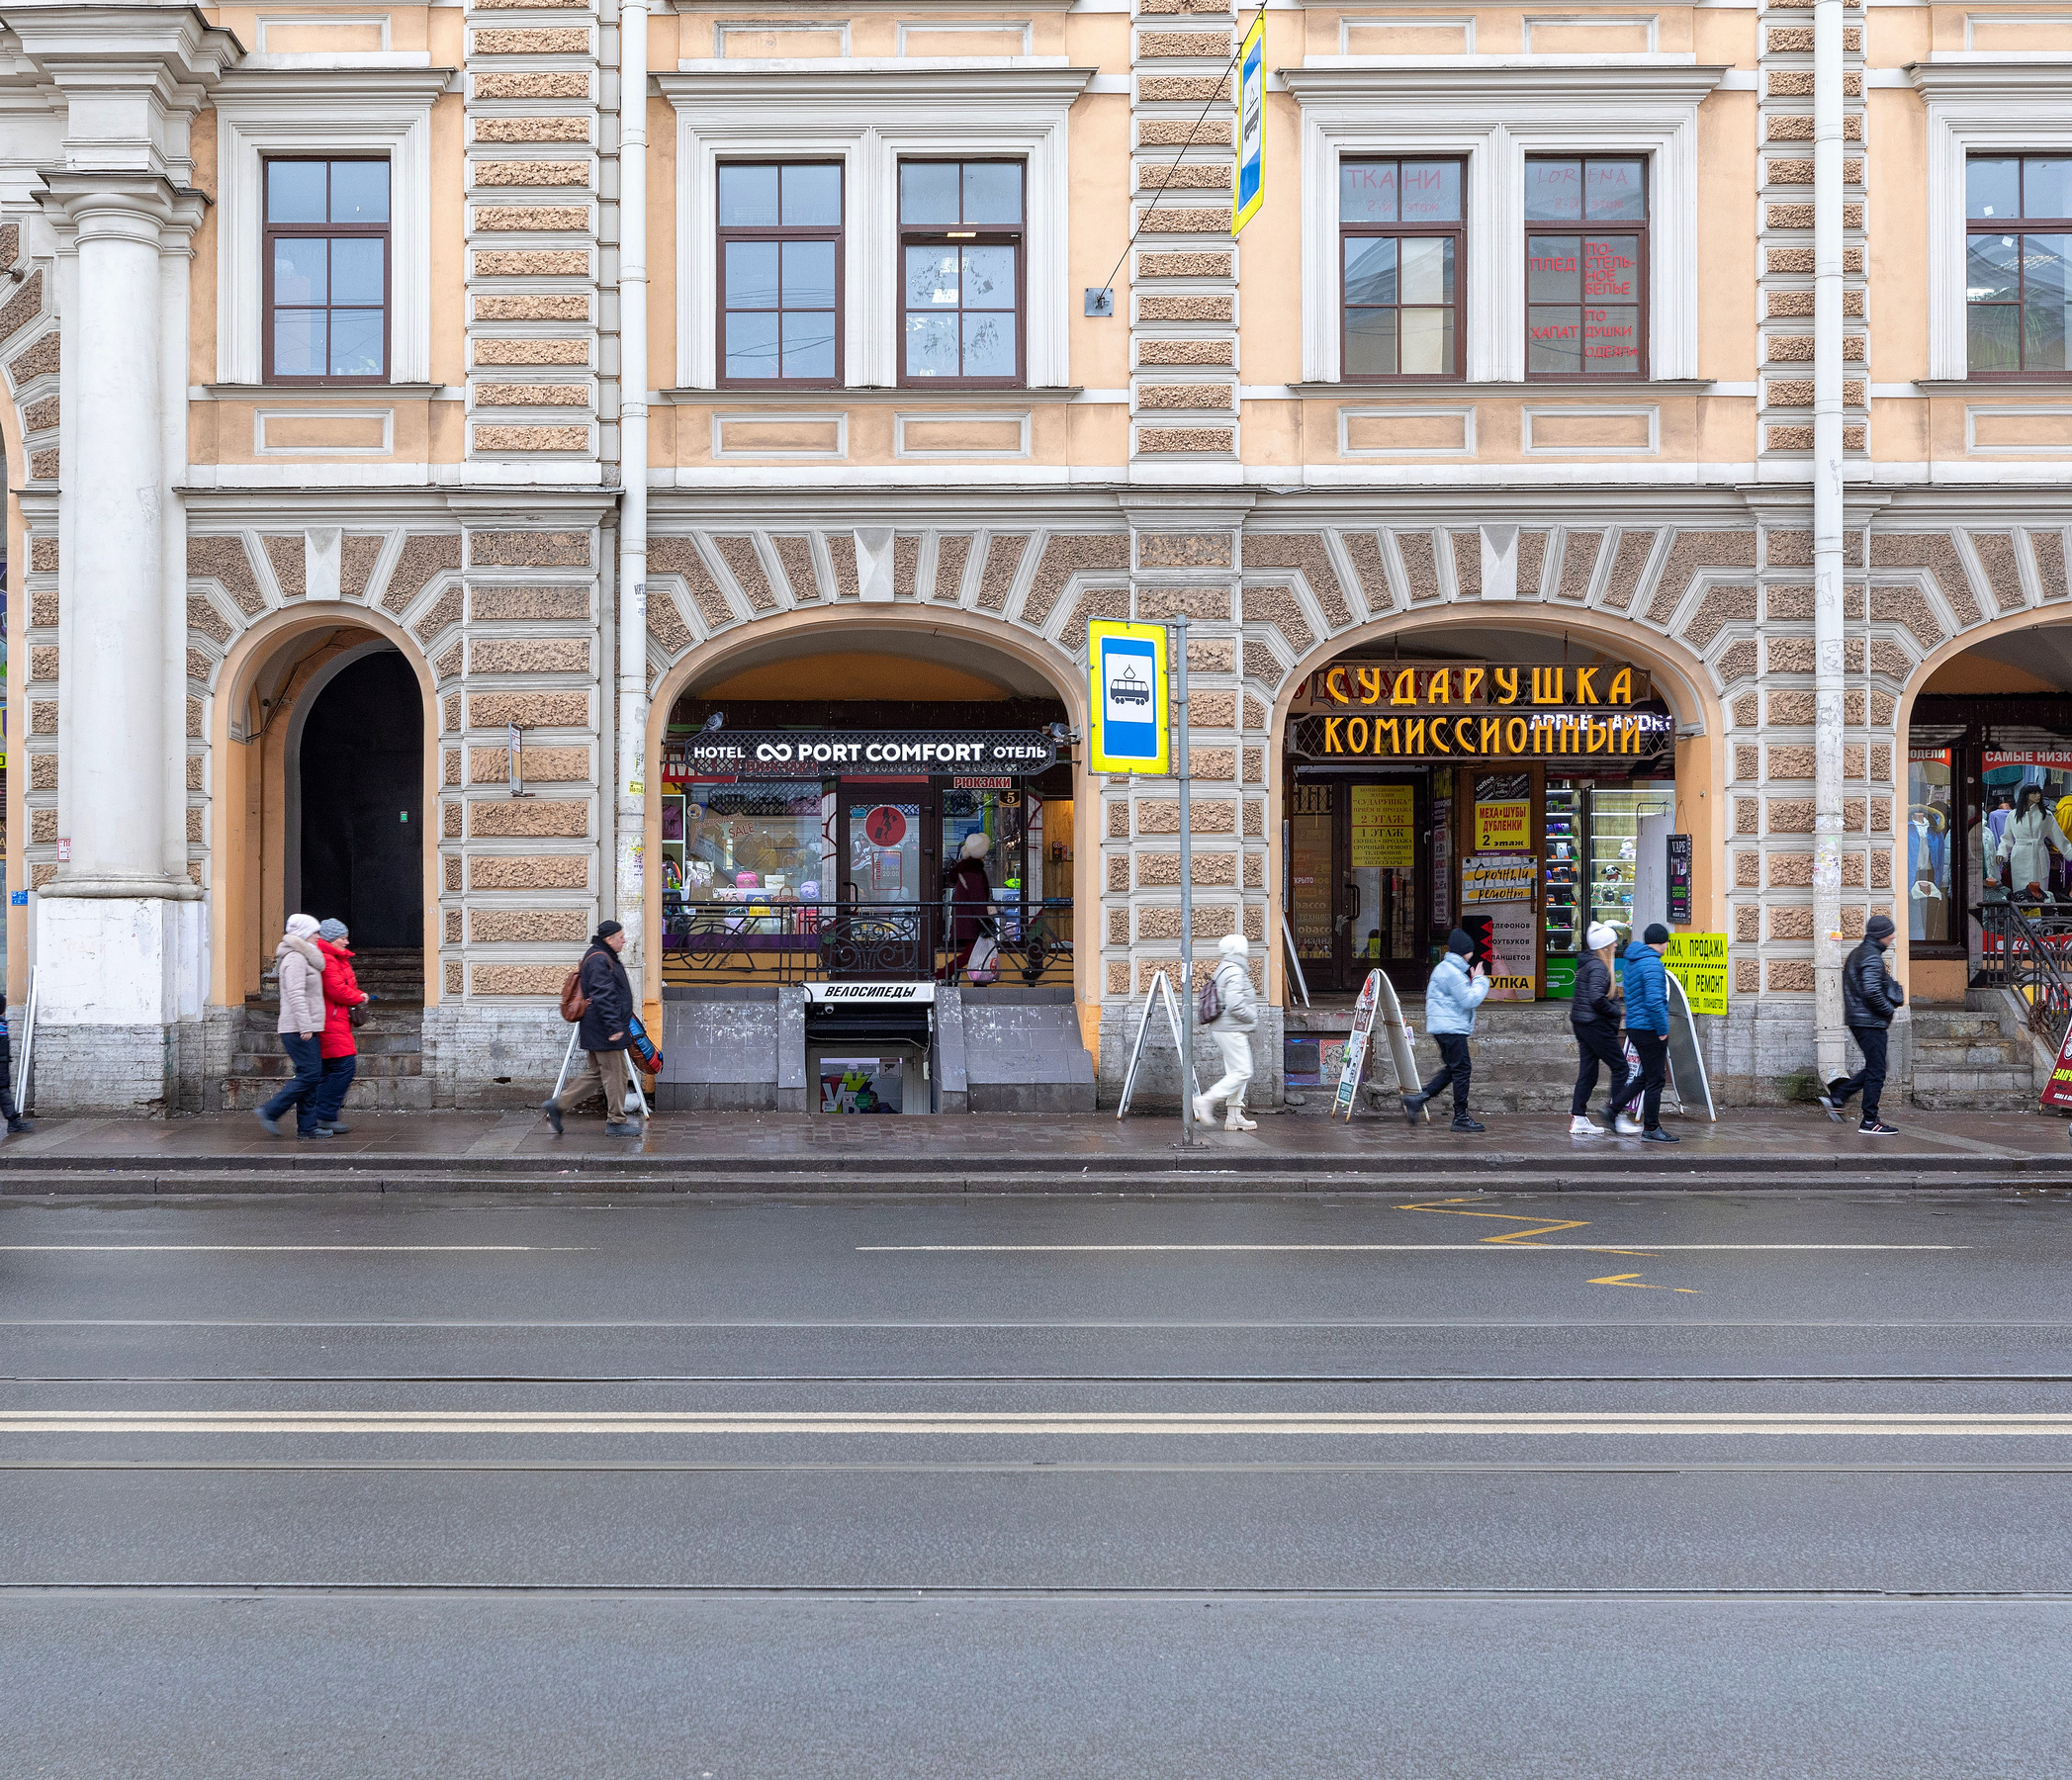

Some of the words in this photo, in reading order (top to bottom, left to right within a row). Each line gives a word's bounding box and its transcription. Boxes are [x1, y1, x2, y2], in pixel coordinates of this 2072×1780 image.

[1346, 169, 1441, 190] ТКАНИ
[1538, 168, 1628, 185] LORENA
[1405, 202, 1438, 213] этаж
[1530, 257, 1577, 273] ПЛЕД
[1585, 269, 1616, 282] НОЕ
[1585, 282, 1631, 295] БЕЛЬЕ
[1585, 310, 1607, 321] ПО
[1585, 325, 1633, 338] ДУШКИ
[1585, 345, 1639, 359] ОДЕЯЛА
[1325, 667, 1633, 706] СУДАРУШКА
[1323, 715, 1642, 756] КОМИССИОННЫЙ
[694, 747, 746, 758] HOTEL
[798, 744, 861, 761] PORT
[866, 743, 984, 761] COMFORT
[993, 746, 1047, 759] ОТЕЛЬ
[1985, 752, 2033, 762] САМЫЕ
[2036, 752, 2072, 762] НИЗК
[953, 776, 1012, 789] РЮКЗАКИ
[1476, 775, 1495, 792] coffee
[1480, 808, 1499, 819] МЕХА
[1502, 806, 1526, 818] ШУБЫ
[1361, 815, 1368, 824] 2
[1371, 815, 1404, 824] ЭТАЖ
[728, 822, 756, 839] SALE
[1370, 829, 1404, 838] ЭТАЖ
[1484, 820, 1523, 834] ДУБЛЕНКИ
[1483, 835, 1490, 846] 2
[1671, 841, 1687, 853] VAPE
[1474, 863, 1530, 887] Срочный
[1478, 888, 1525, 904] ремонт
[1689, 939, 1724, 960] ПРОДАЖА
[1489, 977, 1529, 989] УПКА
[1695, 974, 1724, 994] РЕМОНТ
[825, 987, 917, 999] ВЕЛОСИПЕДЫ
